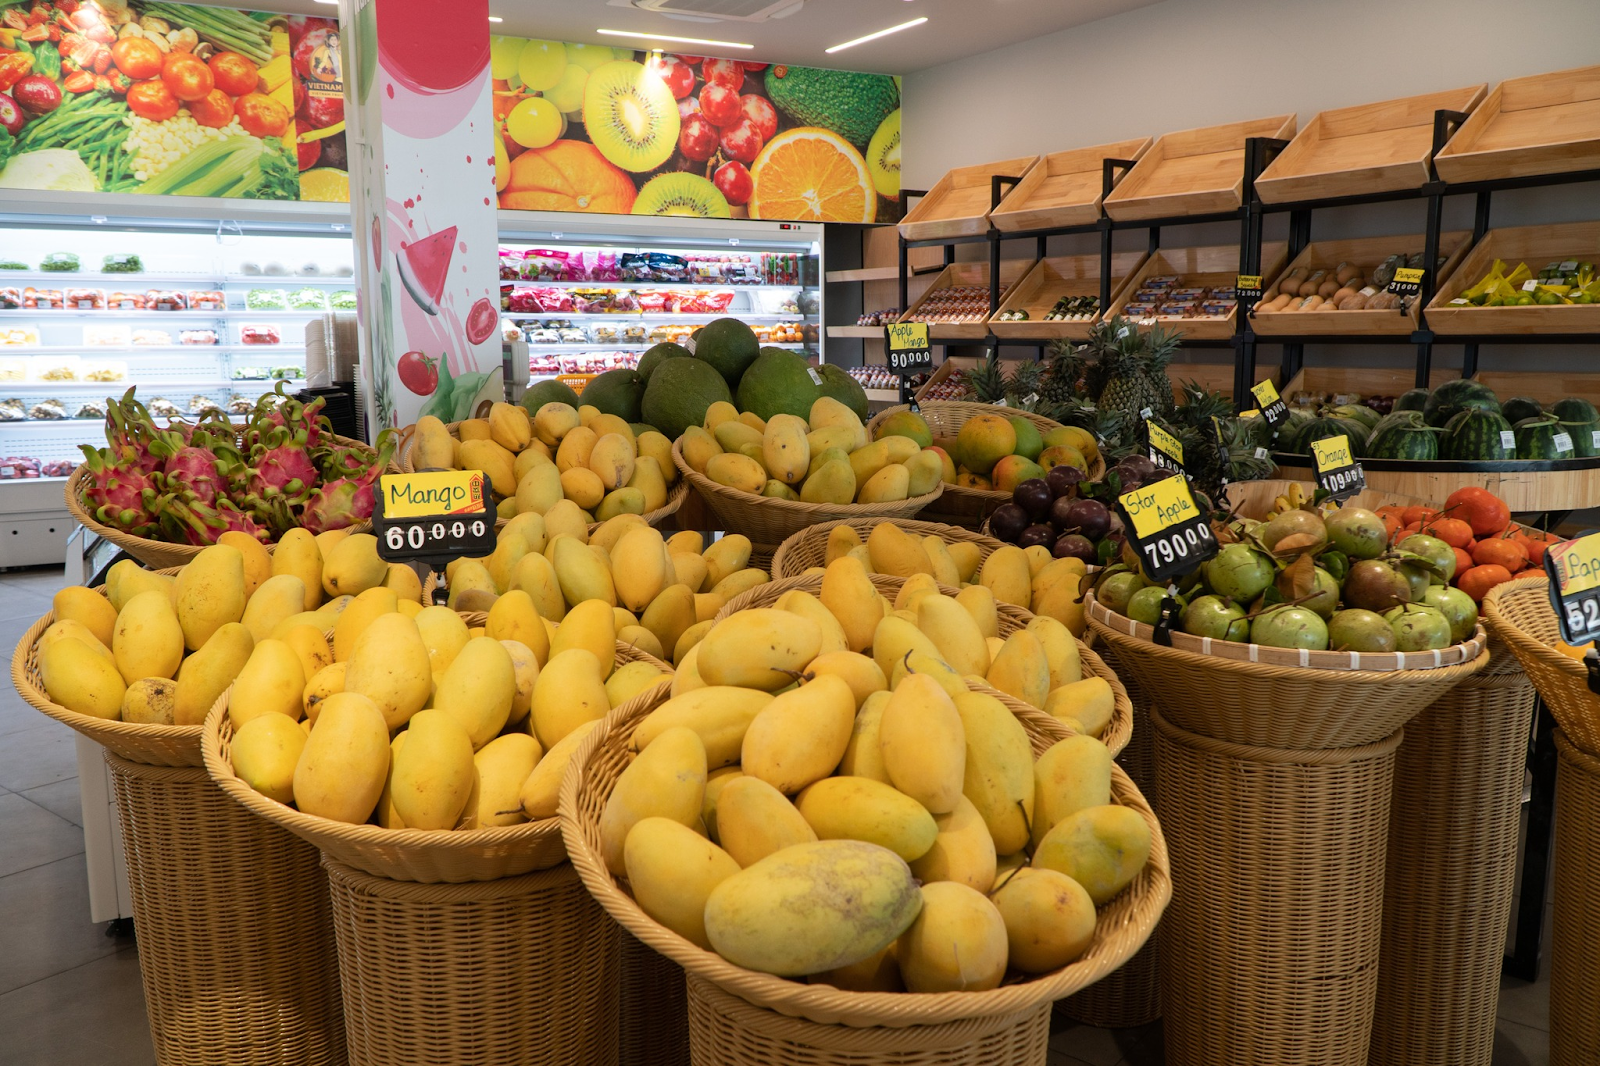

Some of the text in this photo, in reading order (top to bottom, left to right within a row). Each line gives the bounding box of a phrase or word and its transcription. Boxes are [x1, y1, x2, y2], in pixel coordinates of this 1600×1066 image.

[307, 82, 342, 91] VIETNAM
[890, 324, 913, 341] Apple
[903, 337, 925, 348] Mango
[1149, 422, 1169, 444] Purple
[1317, 448, 1348, 466] Orange
[391, 482, 466, 511] Mango
[1126, 491, 1156, 516] Star
[1156, 496, 1192, 526] Apple
[385, 520, 486, 551] 60.000
